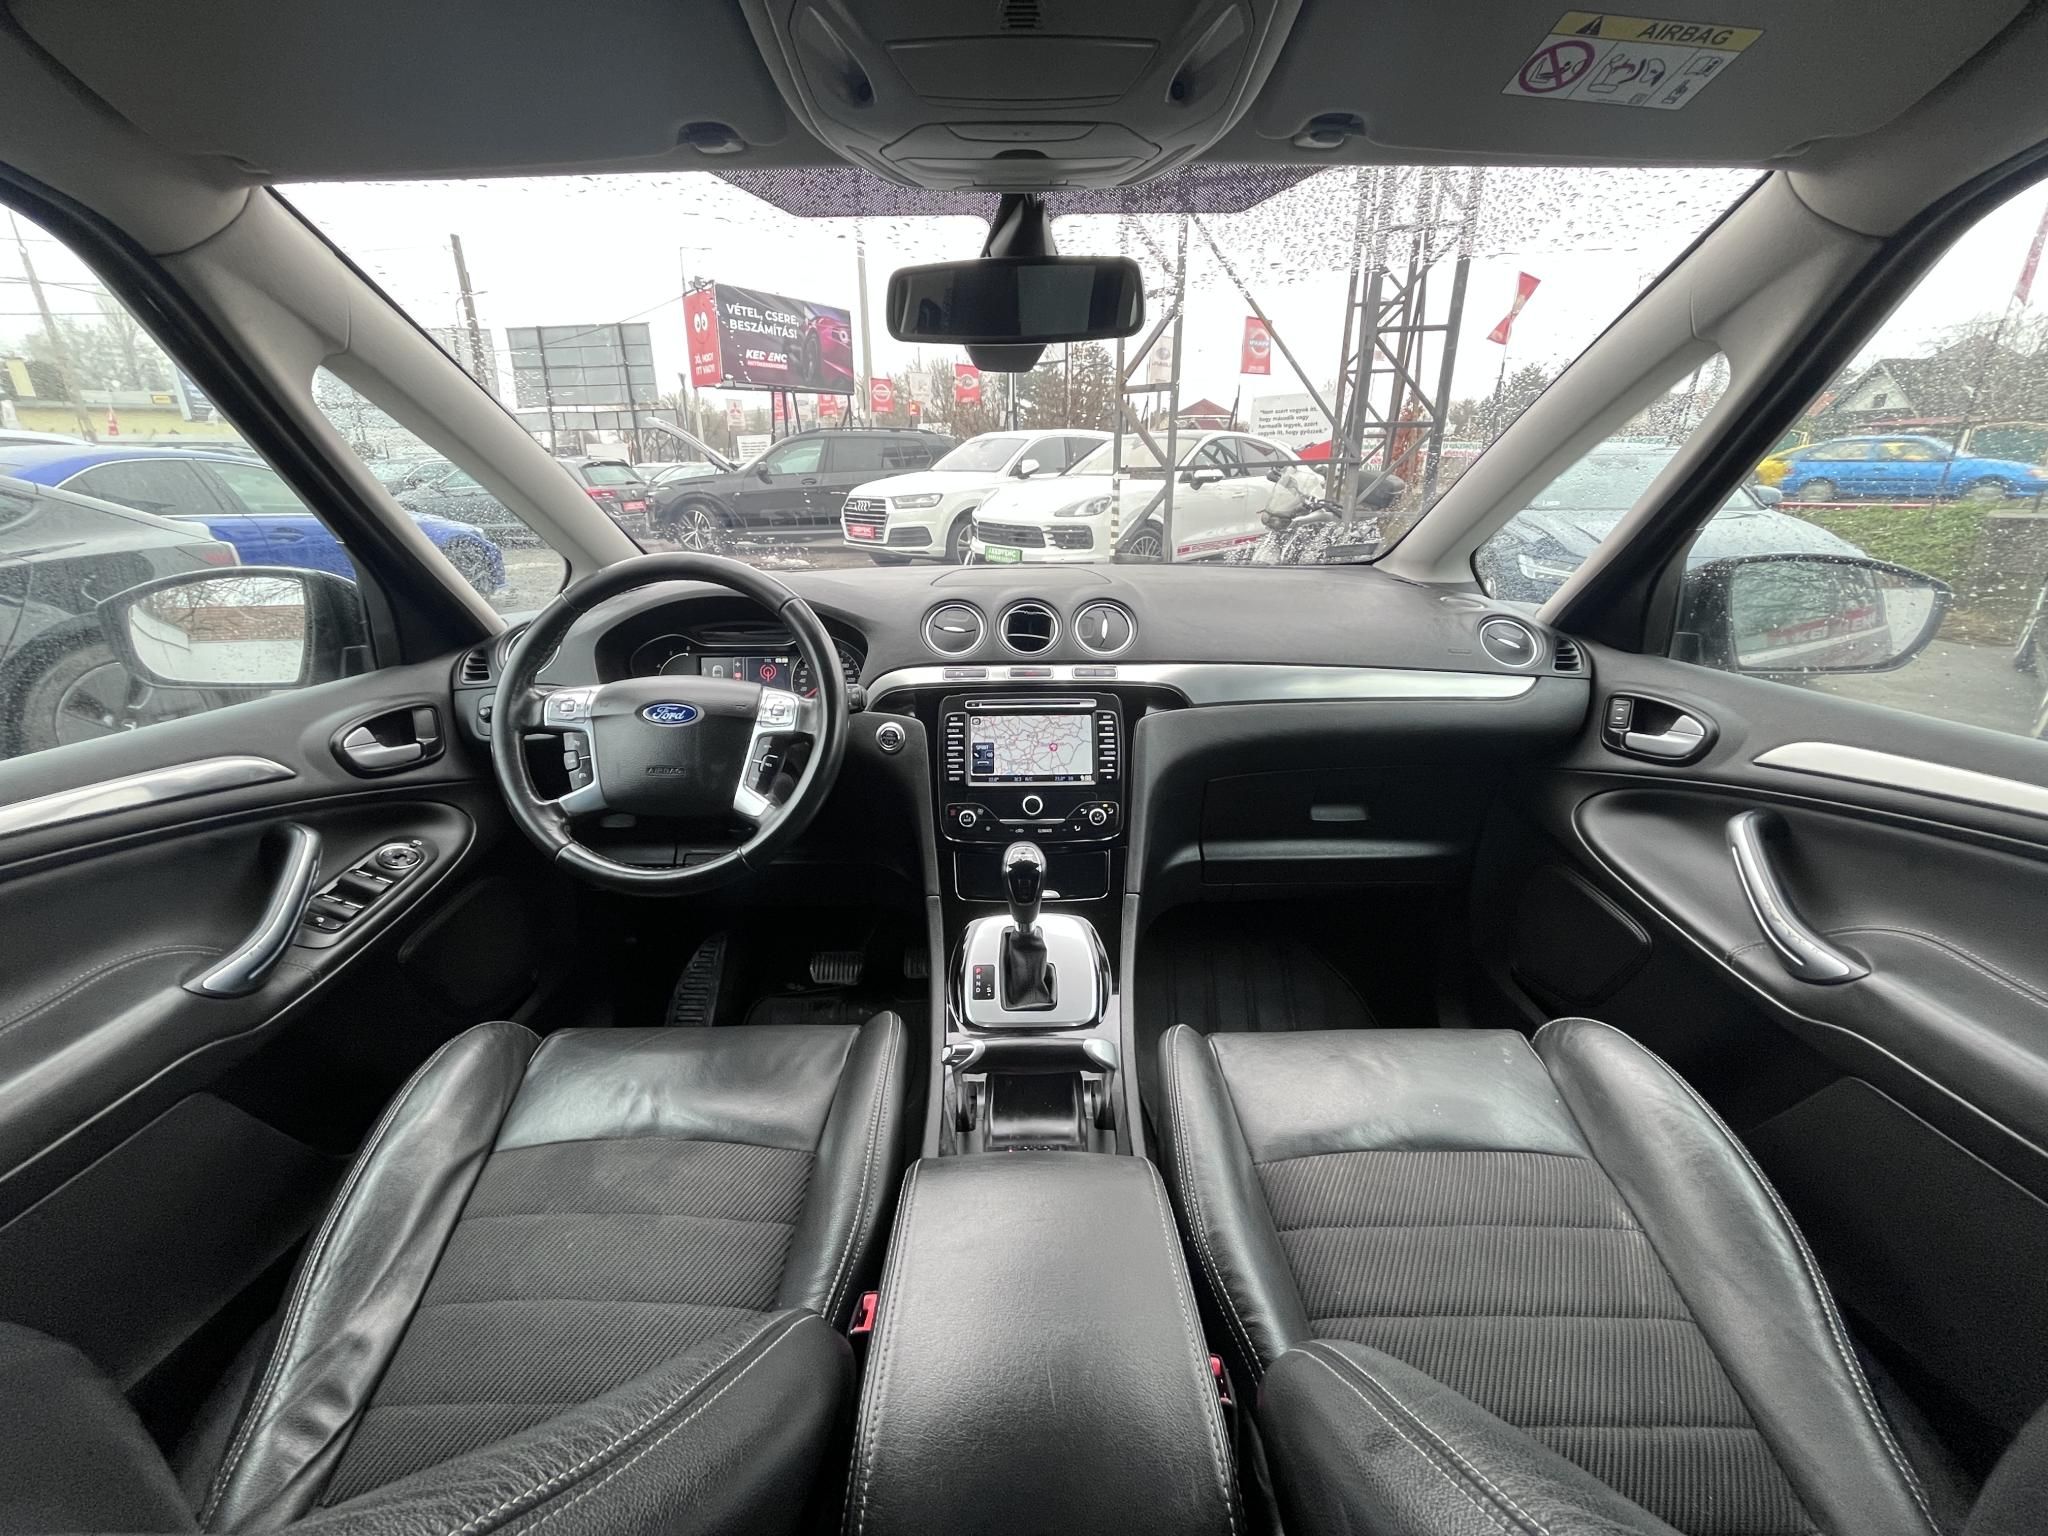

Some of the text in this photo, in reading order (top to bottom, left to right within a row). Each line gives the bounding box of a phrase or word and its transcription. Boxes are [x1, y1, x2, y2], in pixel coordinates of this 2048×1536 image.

[1637, 23, 1733, 46] AIRBAG
[726, 303, 800, 327] VÉTEL, CSERE,
[729, 319, 798, 339] BESZÁMÍTÁS!
[652, 706, 686, 720] Ford
